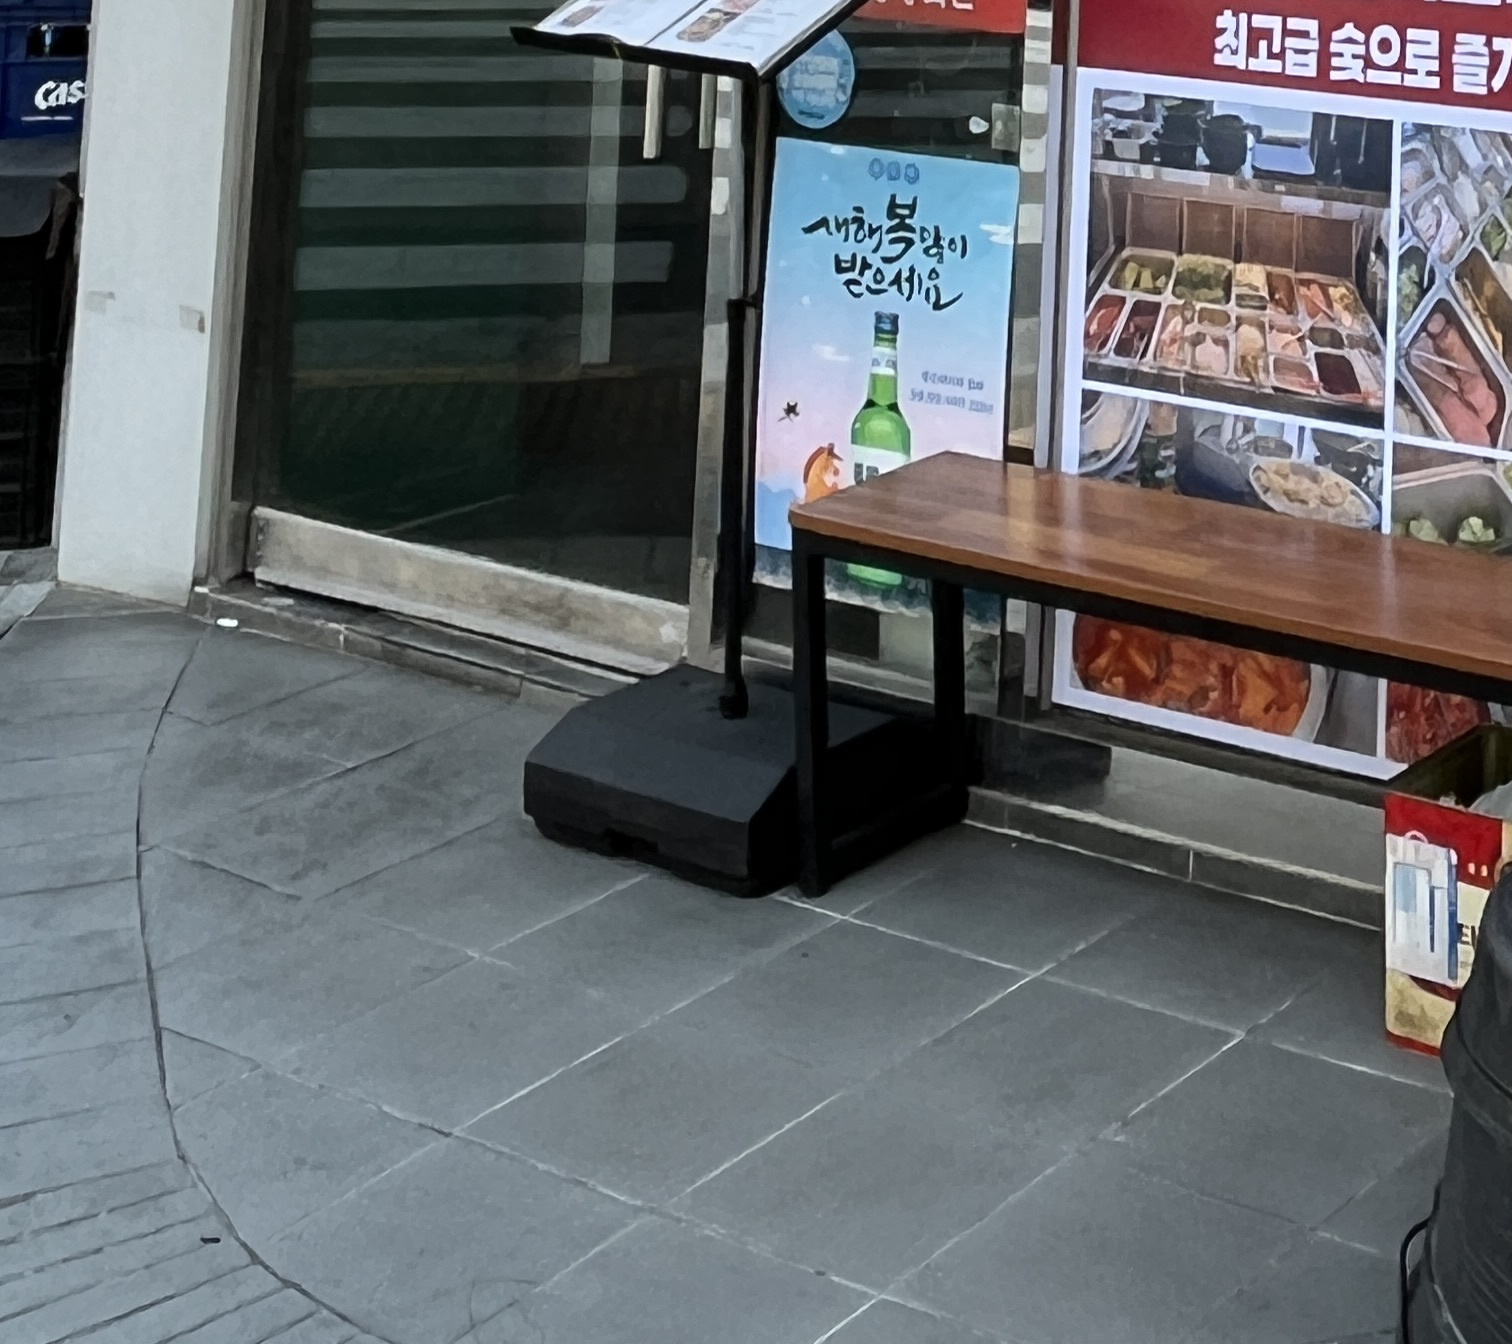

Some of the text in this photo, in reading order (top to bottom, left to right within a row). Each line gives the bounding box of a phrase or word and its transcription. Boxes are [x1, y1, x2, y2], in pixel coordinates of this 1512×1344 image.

[1212, 8, 1320, 78] 최고급
[1328, 21, 1441, 90] 숯으로
[801, 205, 884, 254] 새해
[879, 192, 918, 264] 복
[833, 252, 964, 311] 받으세요
